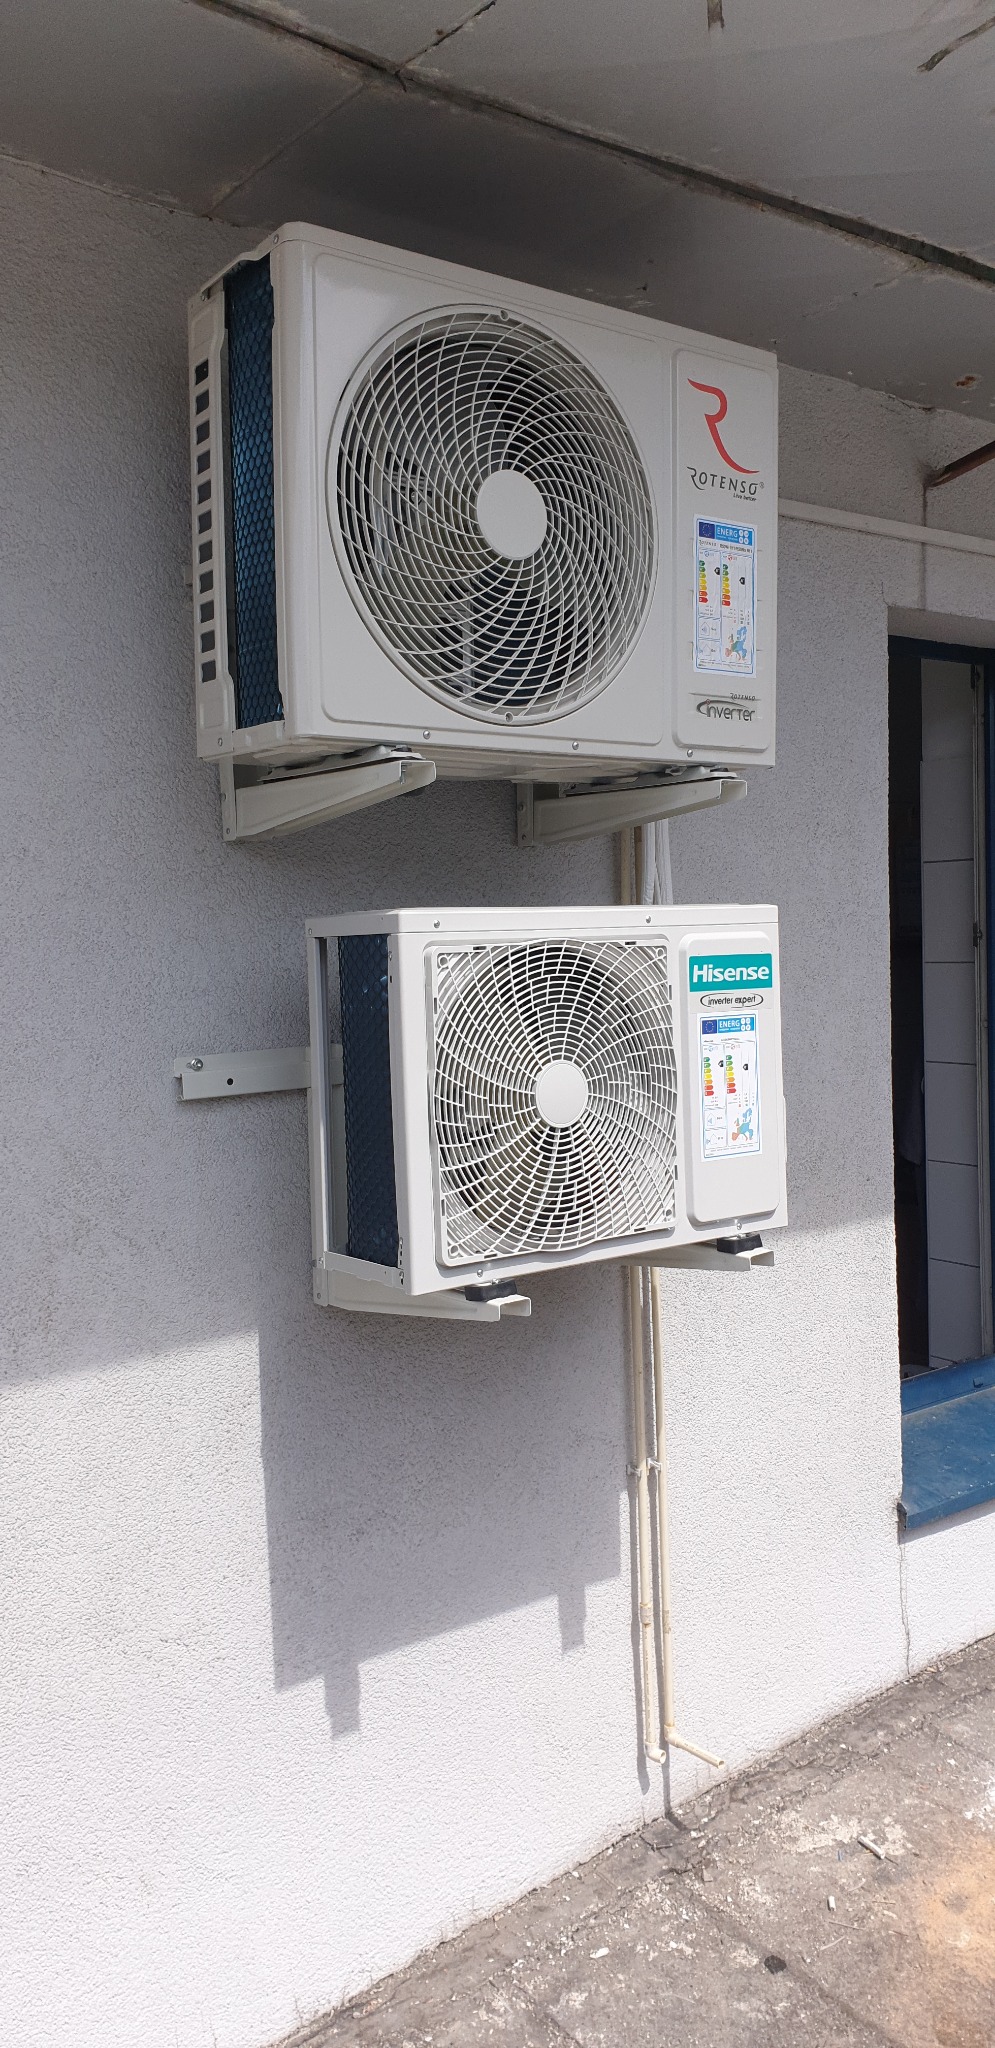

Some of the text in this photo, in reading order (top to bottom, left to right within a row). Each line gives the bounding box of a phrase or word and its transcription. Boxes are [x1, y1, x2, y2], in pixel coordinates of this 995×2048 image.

[717, 527, 738, 538] ENERG
[692, 964, 770, 983] Hisense
[708, 995, 756, 1007] inverter expert
[719, 1019, 741, 1029] ENERG
